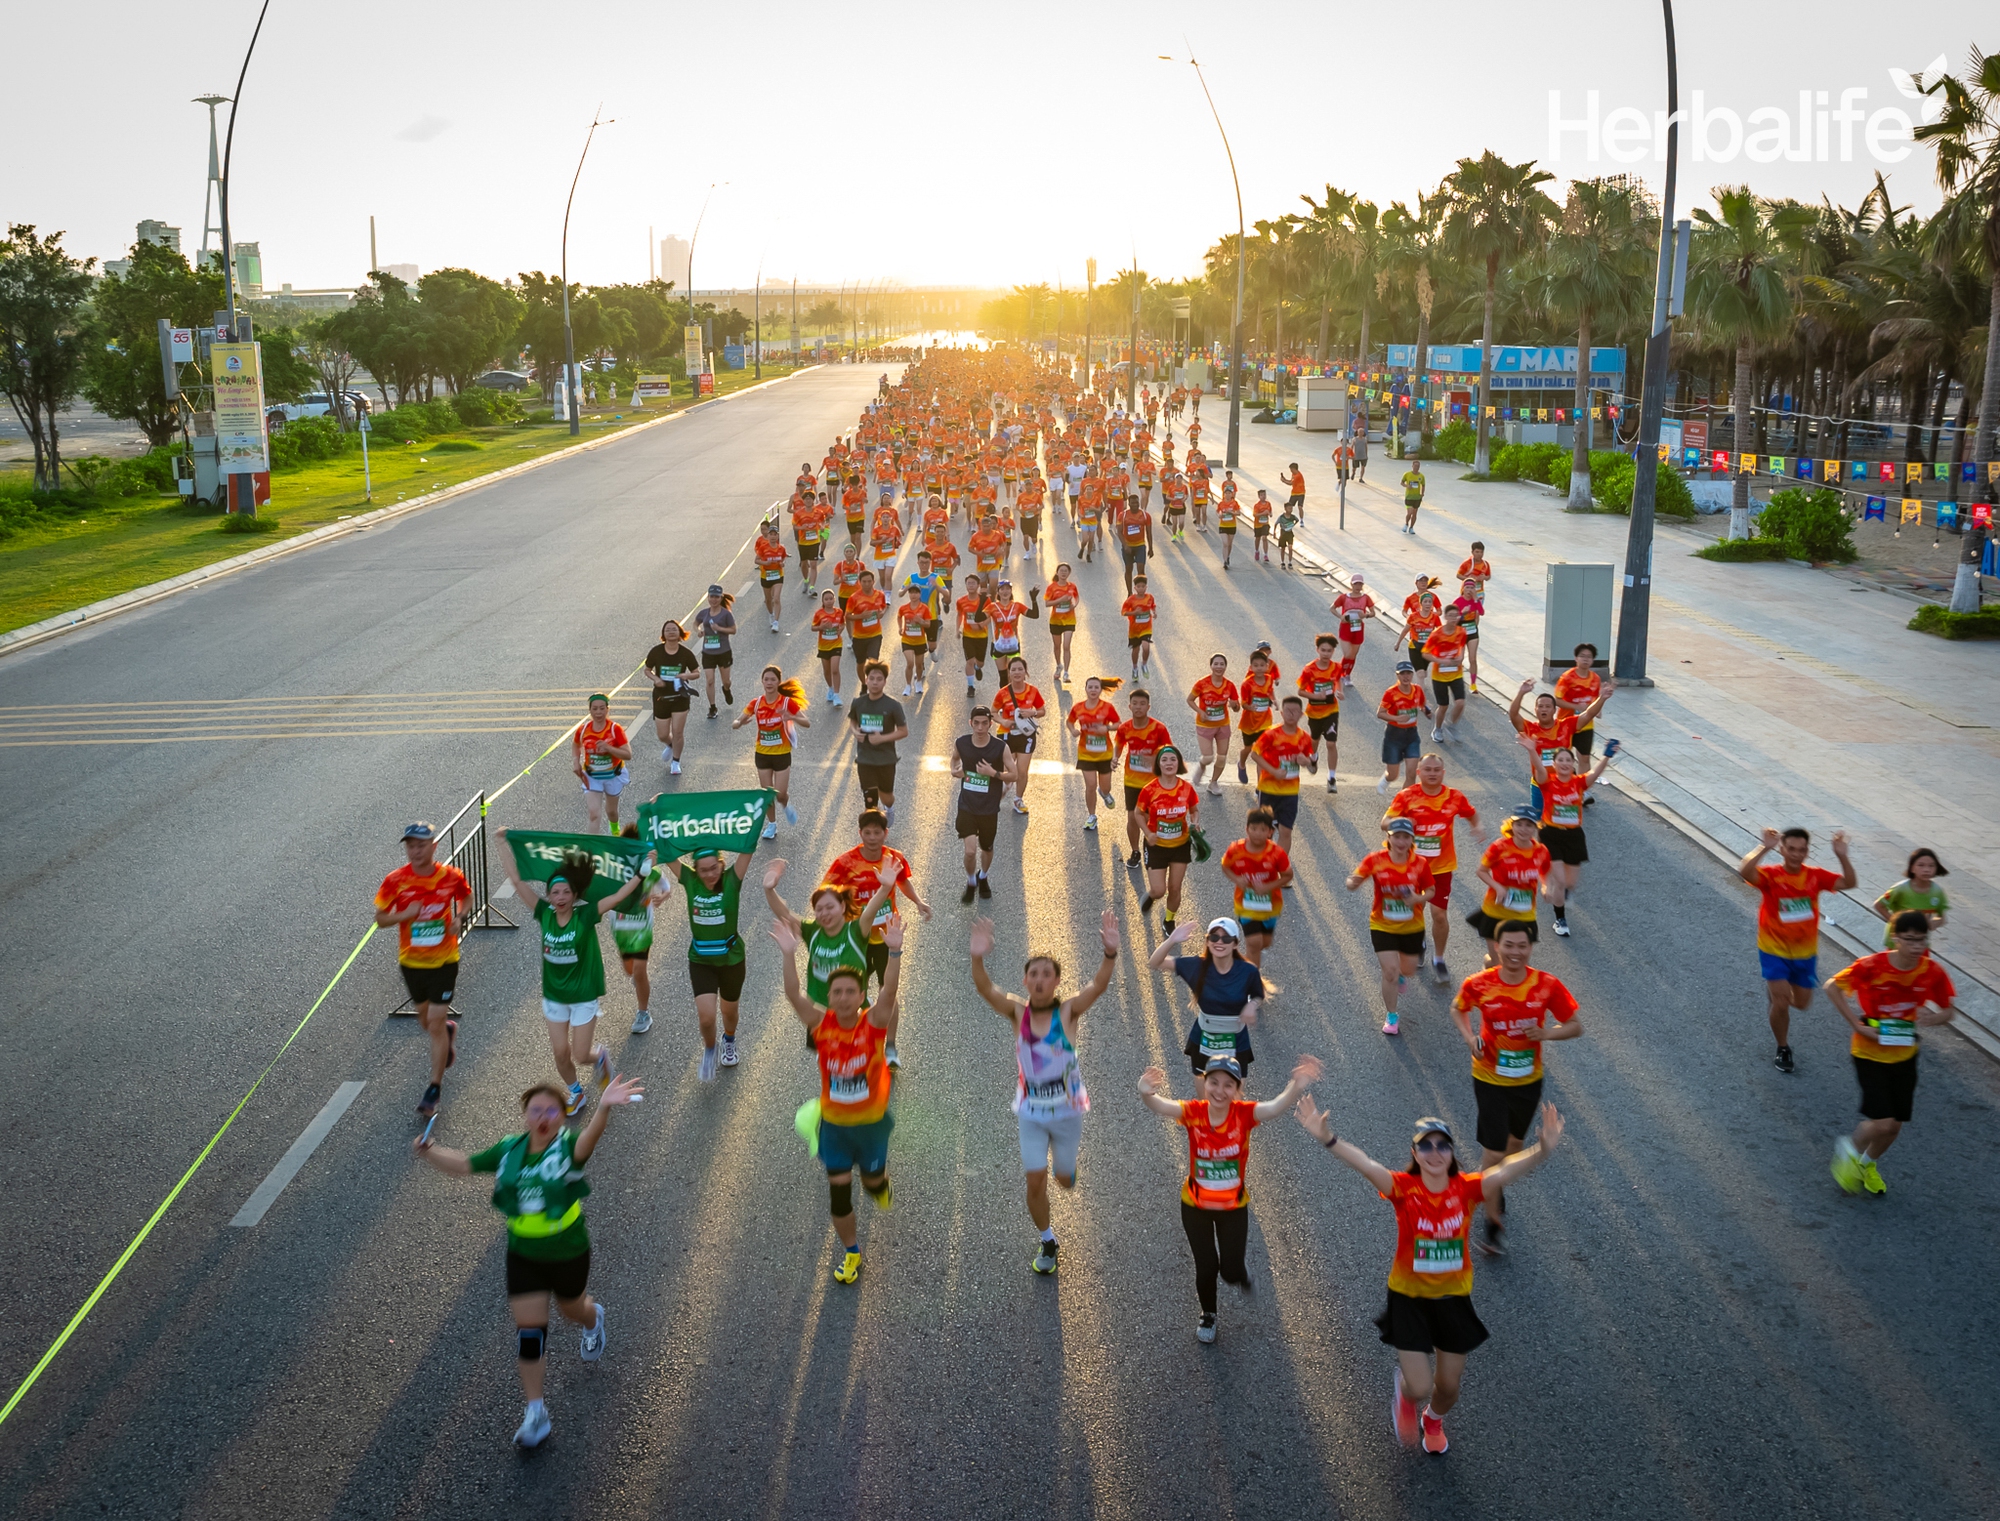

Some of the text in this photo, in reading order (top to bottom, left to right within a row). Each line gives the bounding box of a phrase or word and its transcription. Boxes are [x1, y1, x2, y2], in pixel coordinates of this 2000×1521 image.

[173, 333, 188, 343] 5G
[699, 908, 722, 916] 52159
[876, 905, 891, 916] 2158
